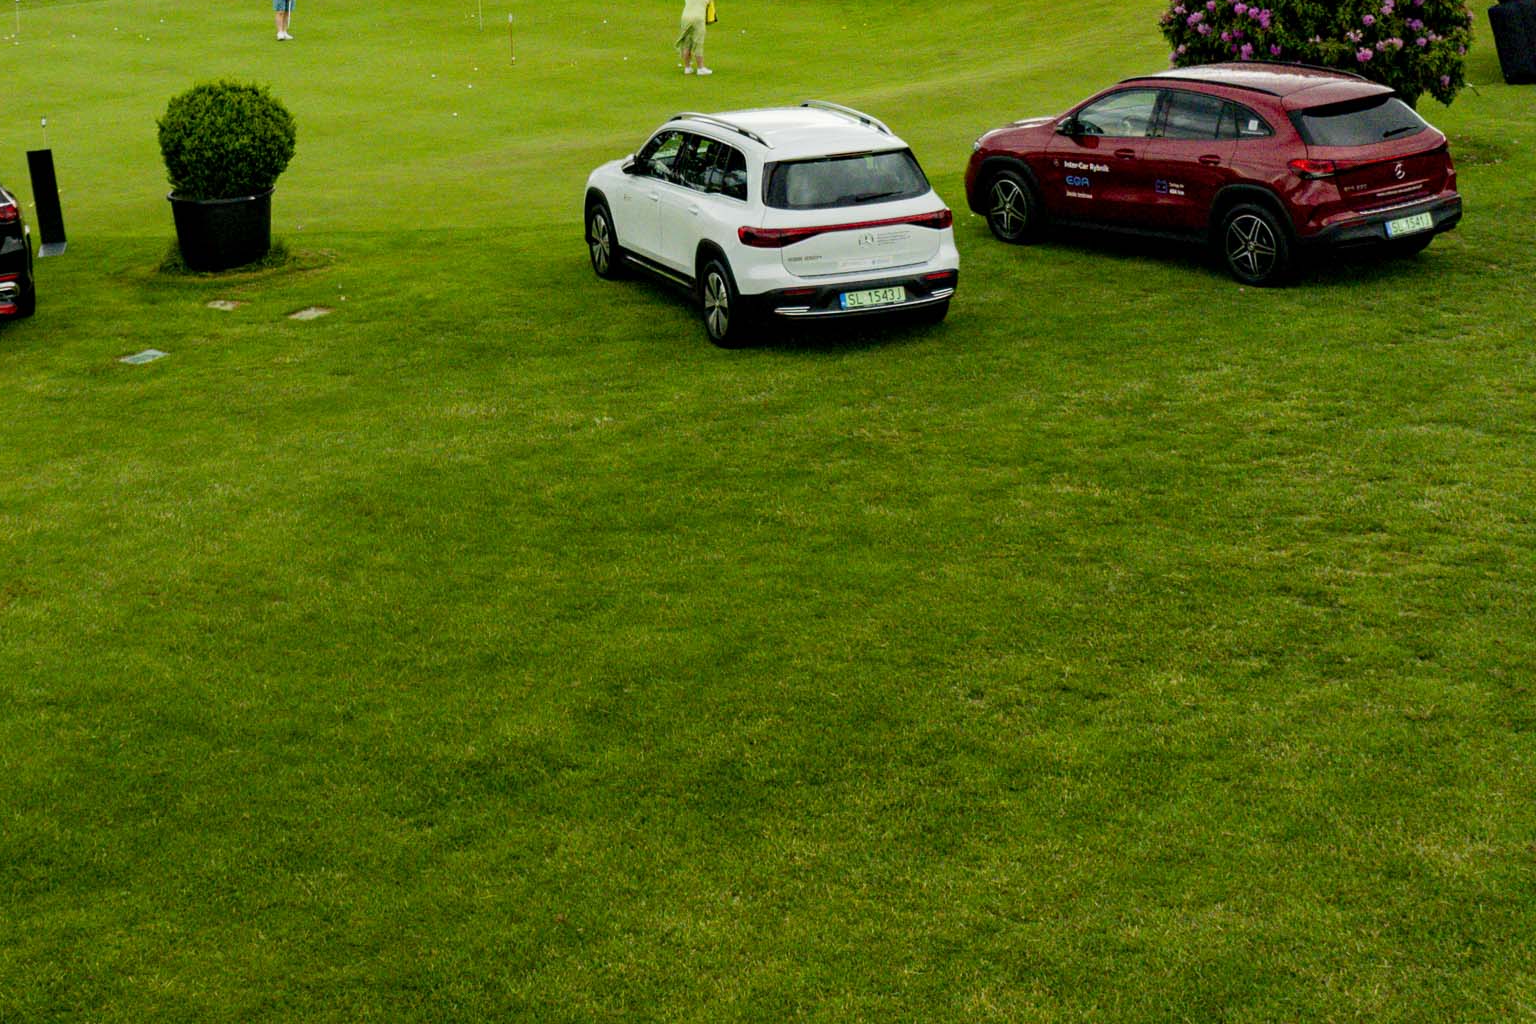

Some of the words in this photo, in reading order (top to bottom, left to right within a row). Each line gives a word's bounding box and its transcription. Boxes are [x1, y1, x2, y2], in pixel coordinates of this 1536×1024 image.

[1391, 222, 1404, 233] SL
[847, 295, 863, 306] SL
[868, 288, 902, 304] 1543J
